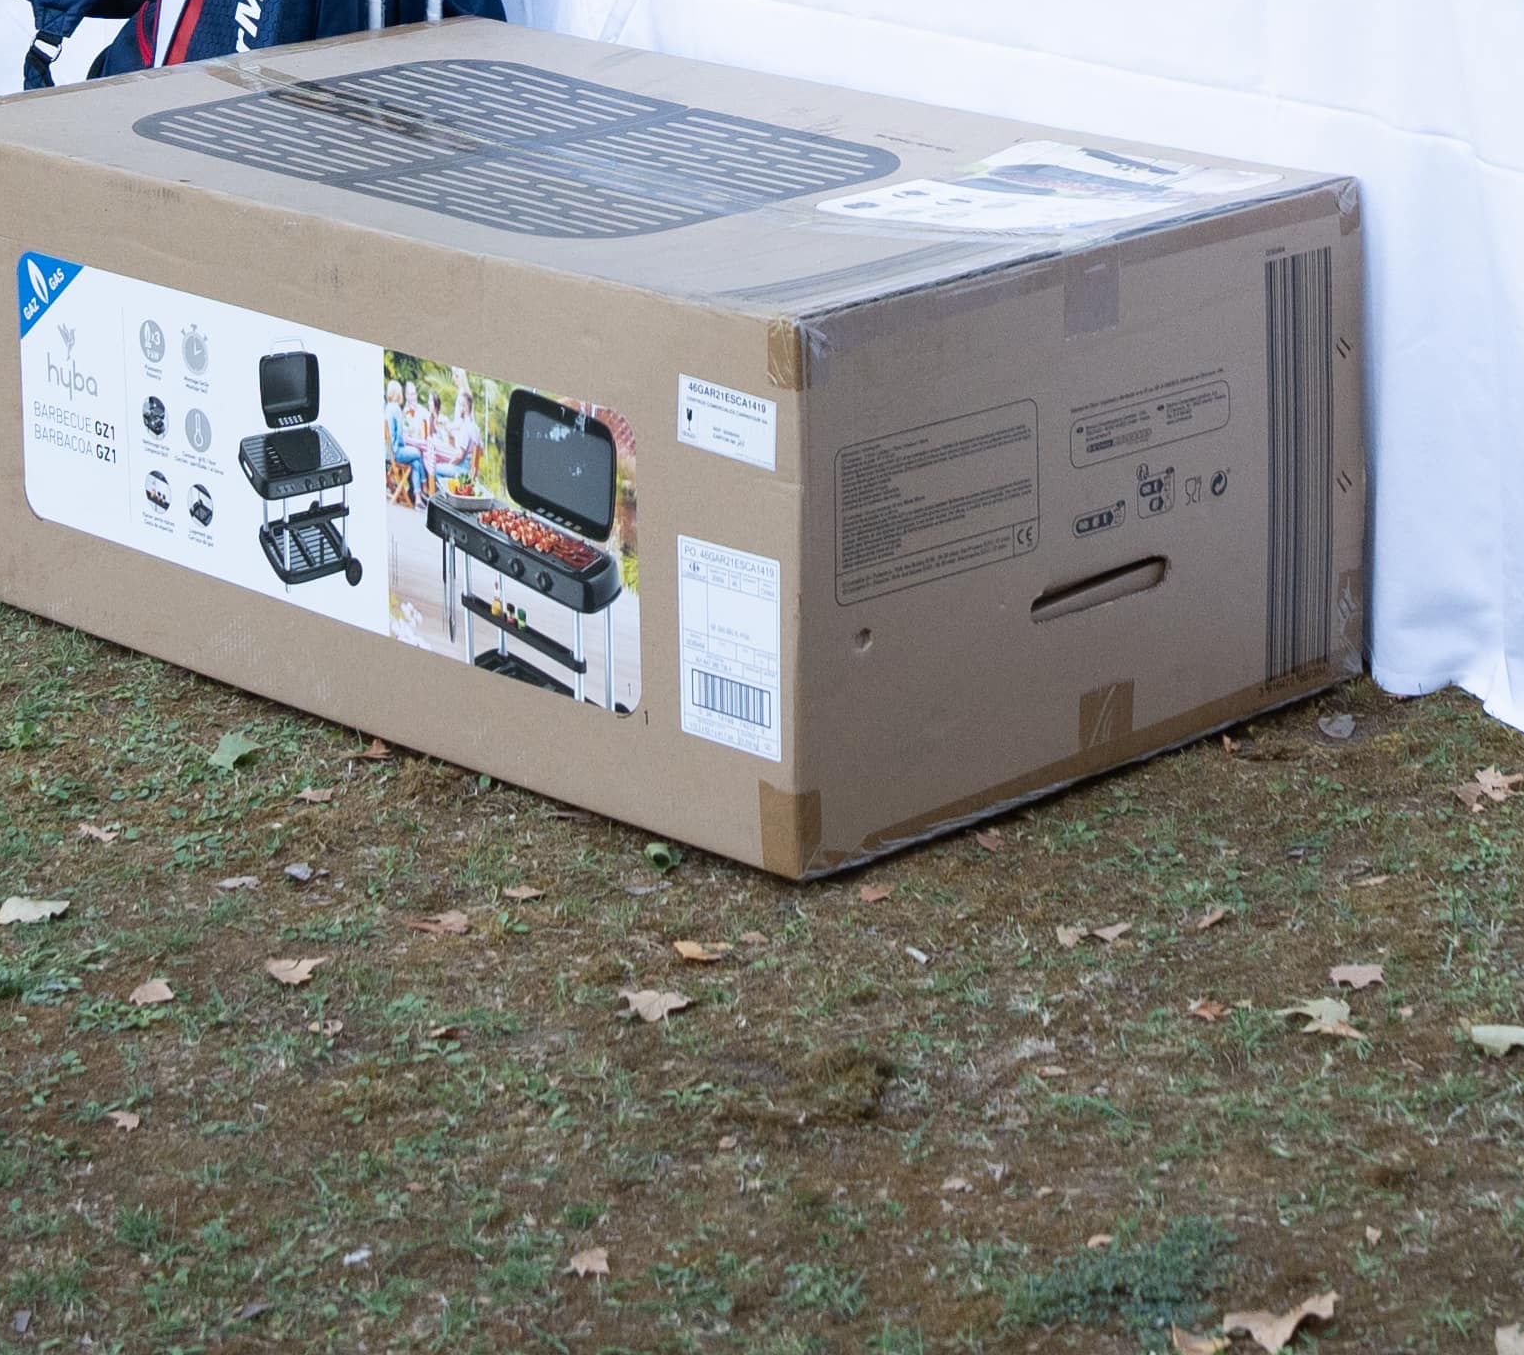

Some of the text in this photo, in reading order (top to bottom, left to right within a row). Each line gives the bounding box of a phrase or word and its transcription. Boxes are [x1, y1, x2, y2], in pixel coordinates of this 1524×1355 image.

[48, 267, 65, 291] GAS
[22, 297, 41, 321] GAZ
[46, 351, 99, 402] hyba
[33, 400, 116, 441] BARBECUE GZ1
[34, 423, 94, 457] BARBACOA
[96, 443, 117, 465] GZ1
